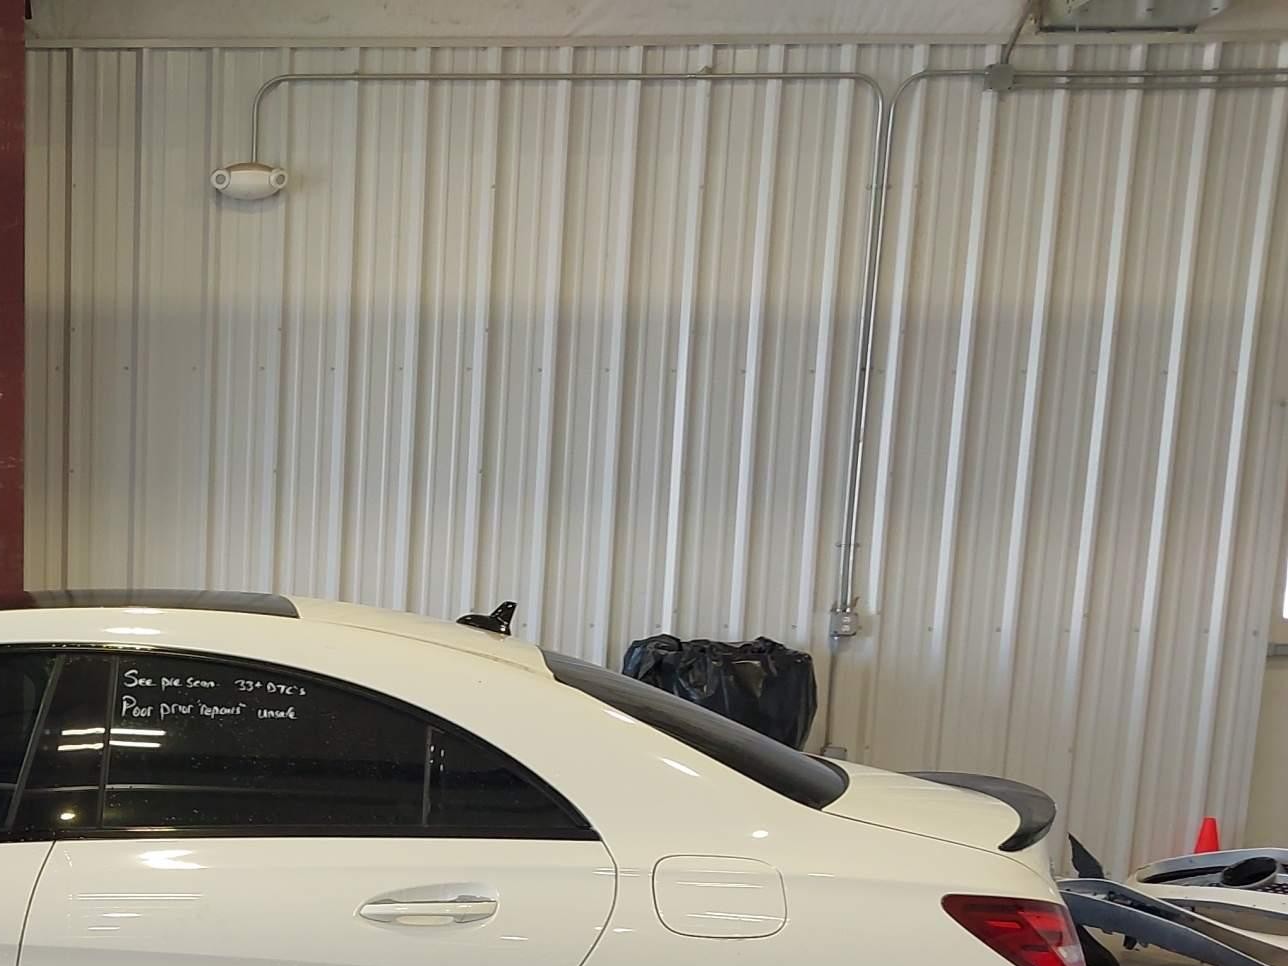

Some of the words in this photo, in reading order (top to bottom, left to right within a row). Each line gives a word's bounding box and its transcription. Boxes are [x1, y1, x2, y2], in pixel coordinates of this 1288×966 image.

[123, 669, 157, 688] See
[122, 695, 153, 717] Poor
[160, 703, 194, 721] prior
